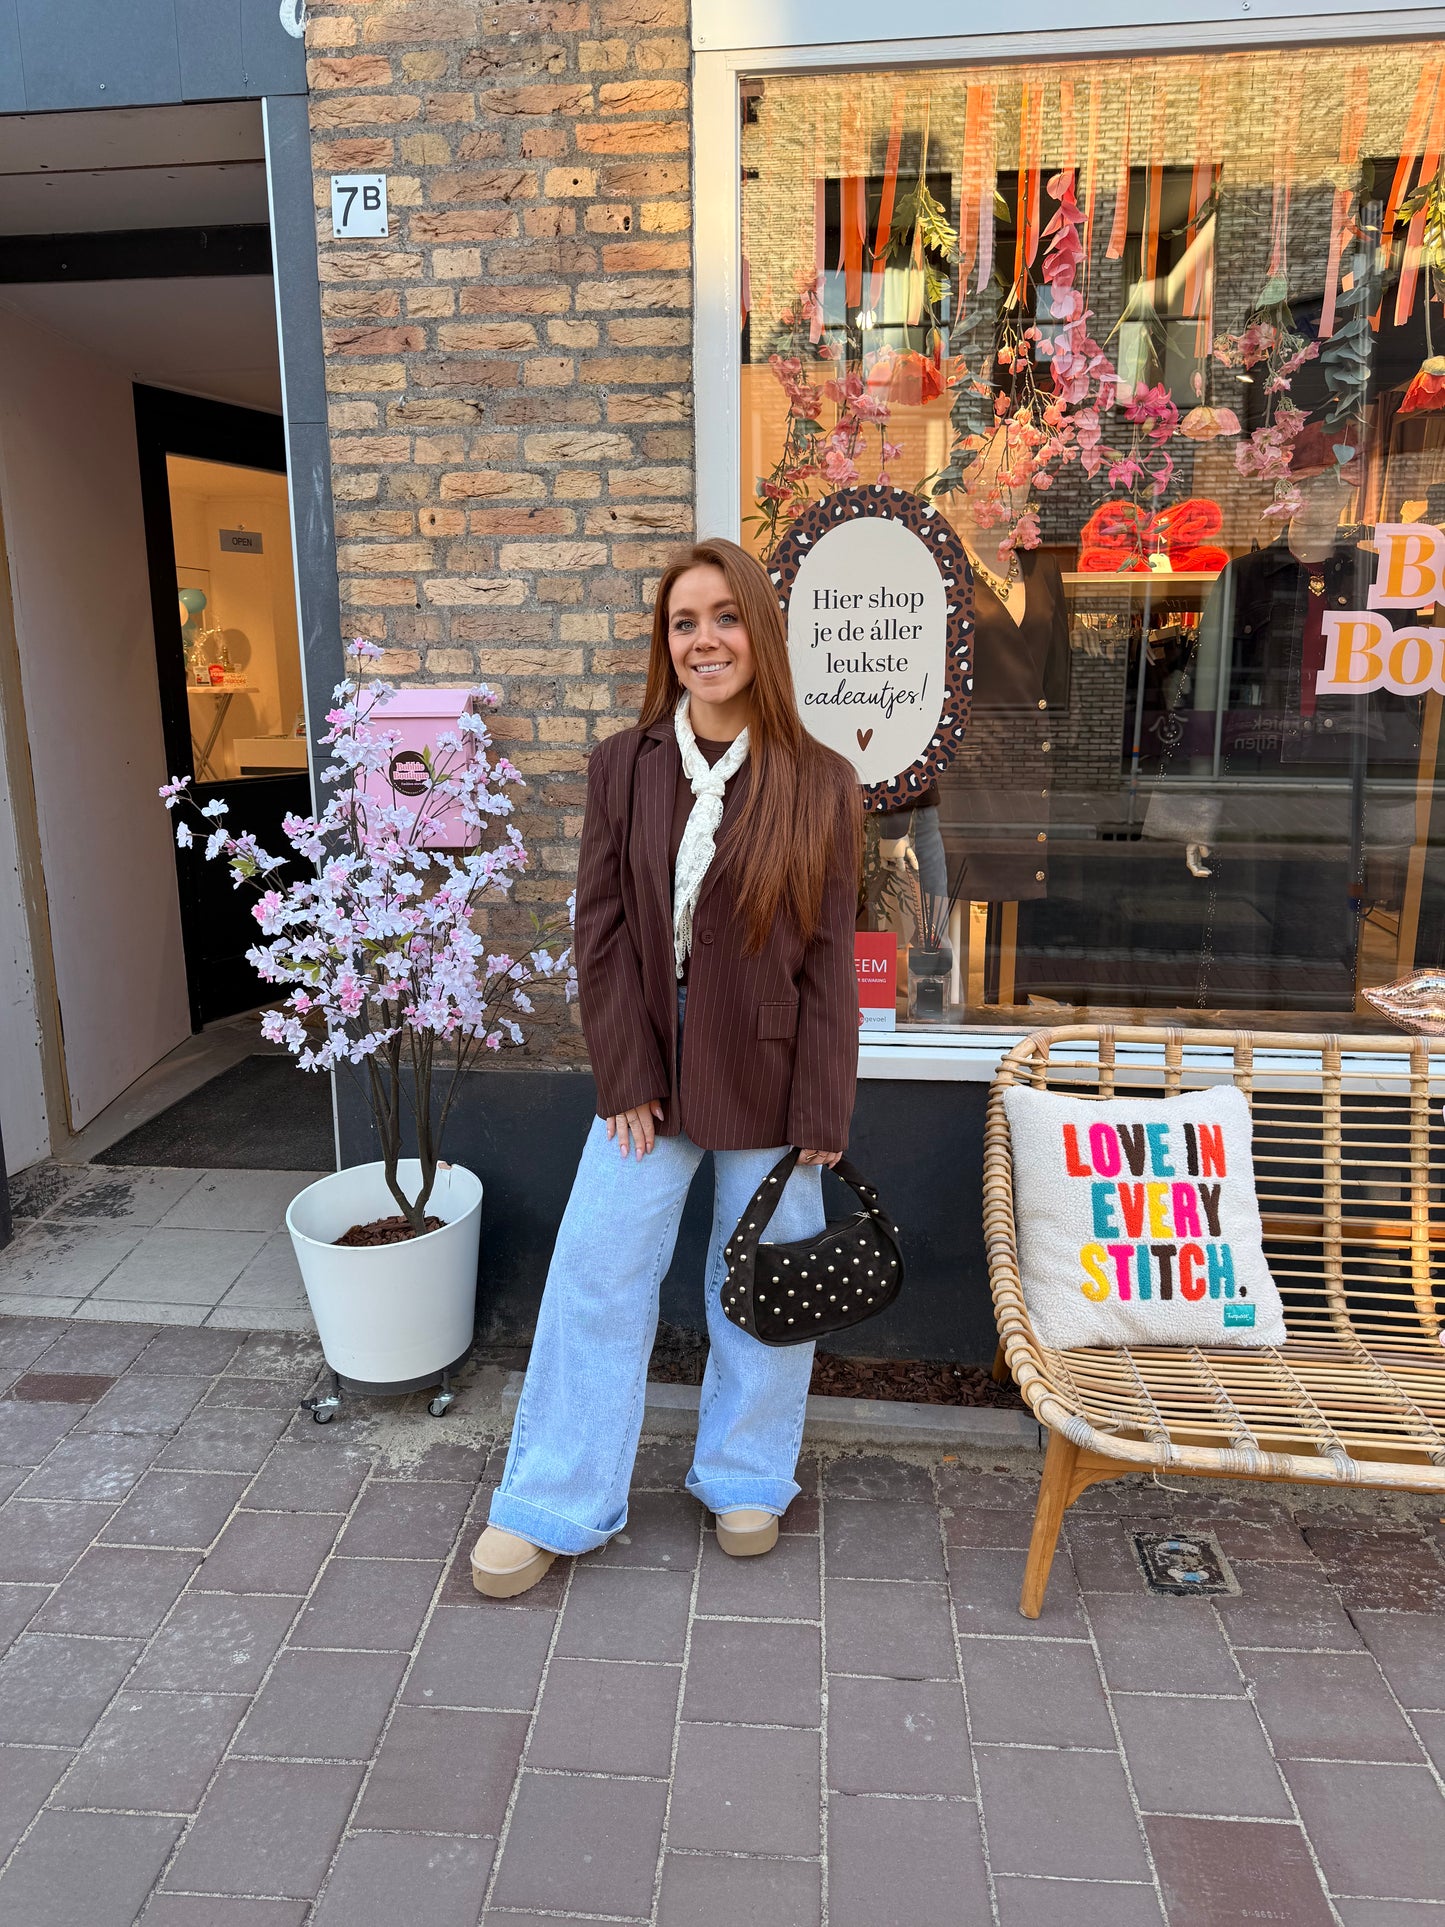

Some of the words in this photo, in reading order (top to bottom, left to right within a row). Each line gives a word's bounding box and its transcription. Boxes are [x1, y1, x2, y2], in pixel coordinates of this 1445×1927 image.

[336, 185, 382, 227] 7B
[231, 536, 253, 547] OPEN
[1377, 532, 1445, 600] B
[812, 588, 864, 610] Hier
[867, 585, 925, 614] shop
[810, 621, 833, 649] je
[837, 619, 865, 642] de
[869, 618, 923, 641] áller
[825, 651, 909, 674] leukste
[803, 672, 929, 720] cadeautjes!
[393, 771, 429, 781] Boutique
[395, 761, 425, 771] Bobbie
[1062, 1122, 1175, 1178] LOVE
[1182, 1122, 1227, 1178] IN
[1091, 1181, 1221, 1239] EVERY
[1079, 1242, 1248, 1302] STITCH.
